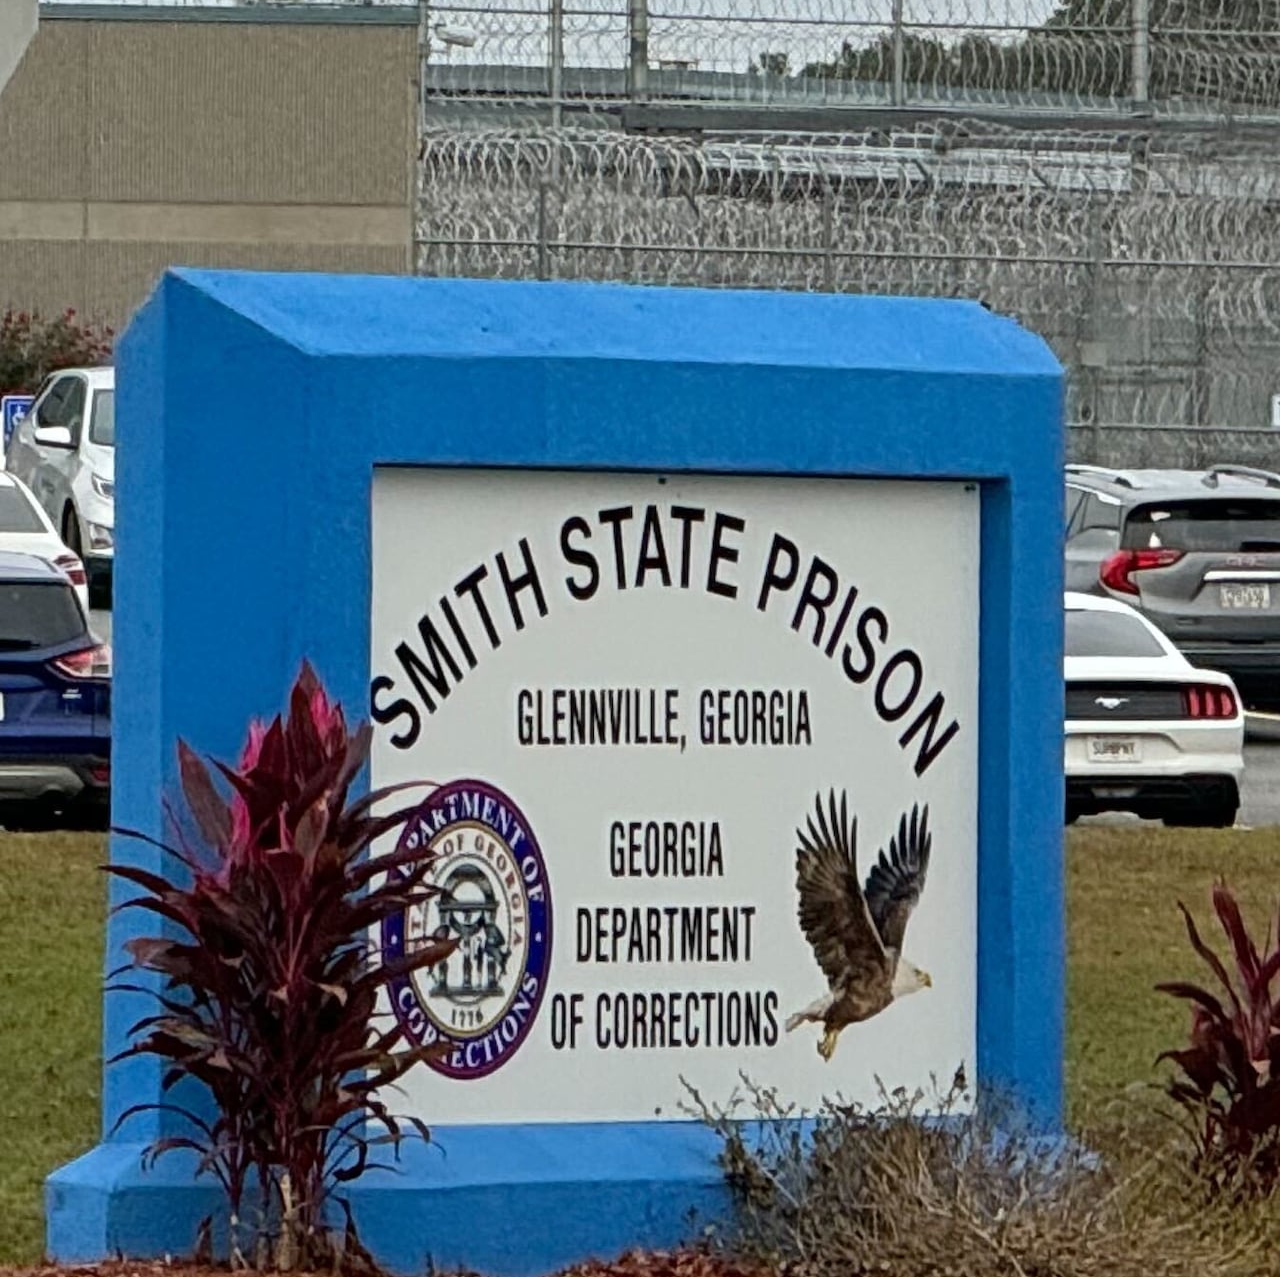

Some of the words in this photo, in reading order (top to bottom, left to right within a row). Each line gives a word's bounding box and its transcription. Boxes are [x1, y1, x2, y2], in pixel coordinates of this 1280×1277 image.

[371, 536, 549, 750] SMITH
[558, 504, 746, 601] STATE
[756, 531, 960, 779] PRISON
[516, 688, 687, 752] GLENNVILLE,
[698, 688, 813, 746] GEORGIA
[609, 820, 725, 878] GEORGIA
[575, 905, 757, 964] DEPARTMENT
[550, 992, 586, 1051] OF
[595, 989, 779, 1050] CORRECTIONS
